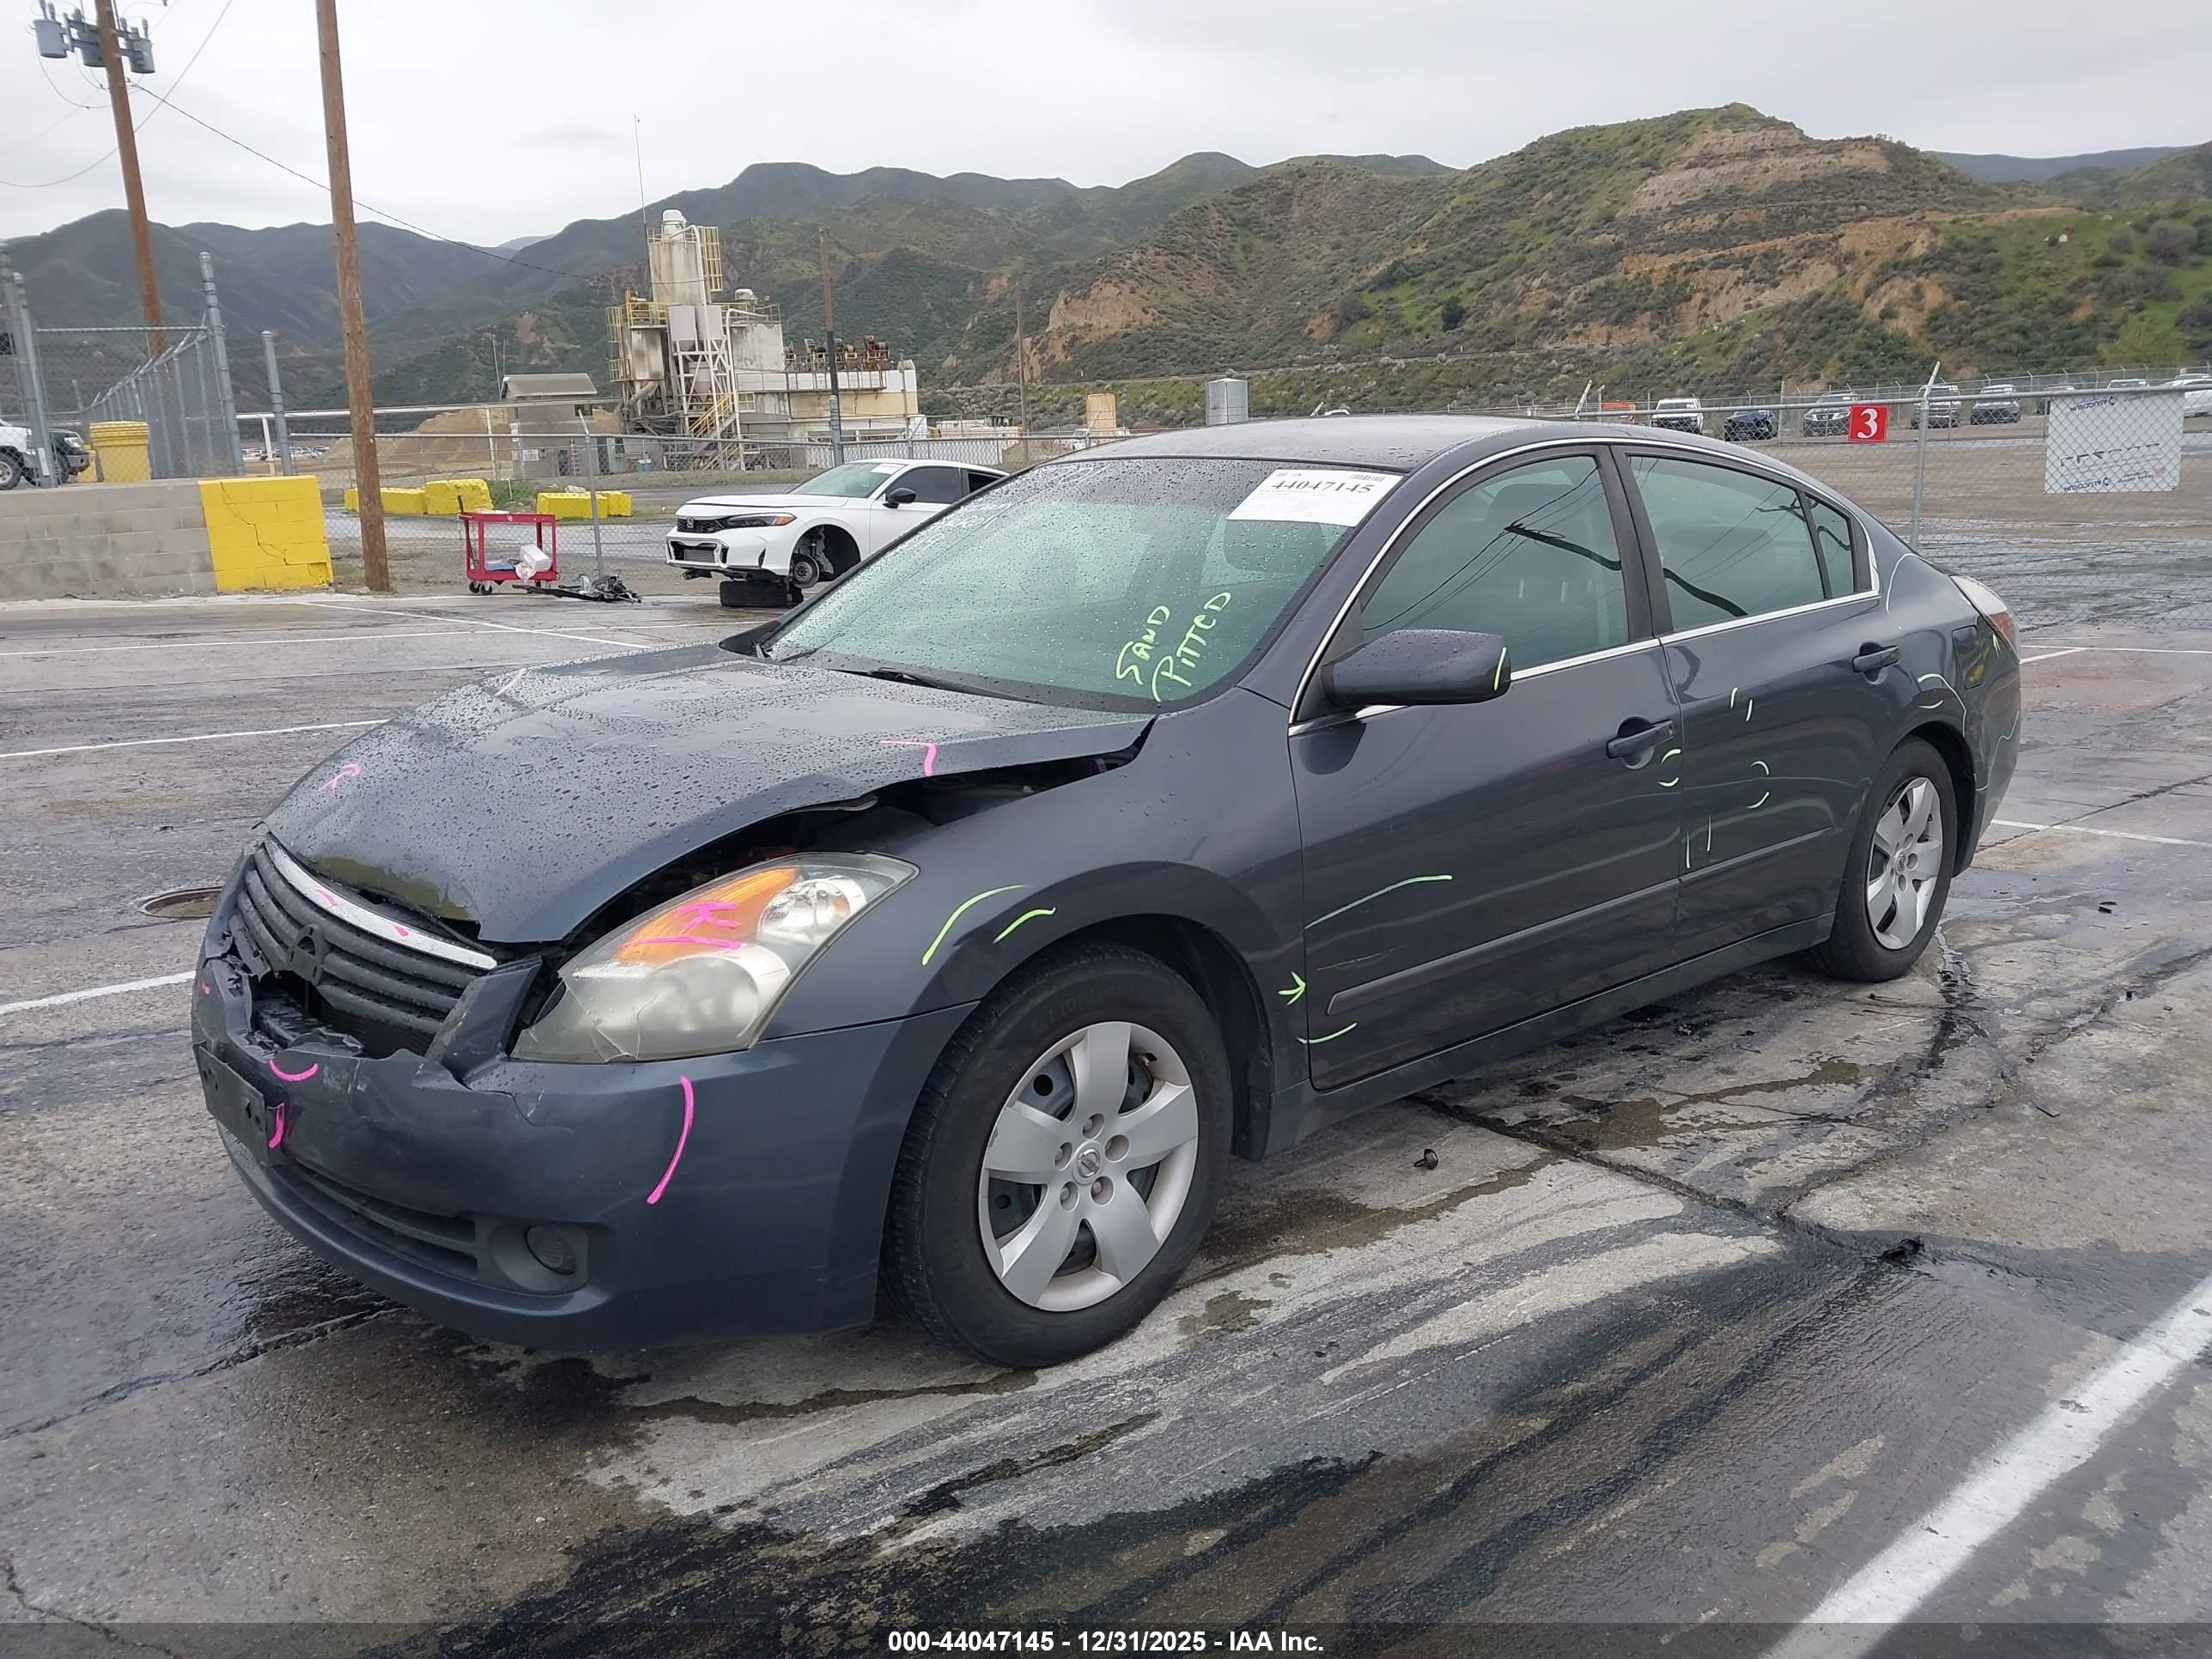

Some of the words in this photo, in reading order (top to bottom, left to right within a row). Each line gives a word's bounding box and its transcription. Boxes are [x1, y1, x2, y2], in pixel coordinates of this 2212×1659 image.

[1856, 408, 1878, 439] 3
[1271, 480, 1375, 494] 44047145
[1115, 605, 1171, 686] SAND
